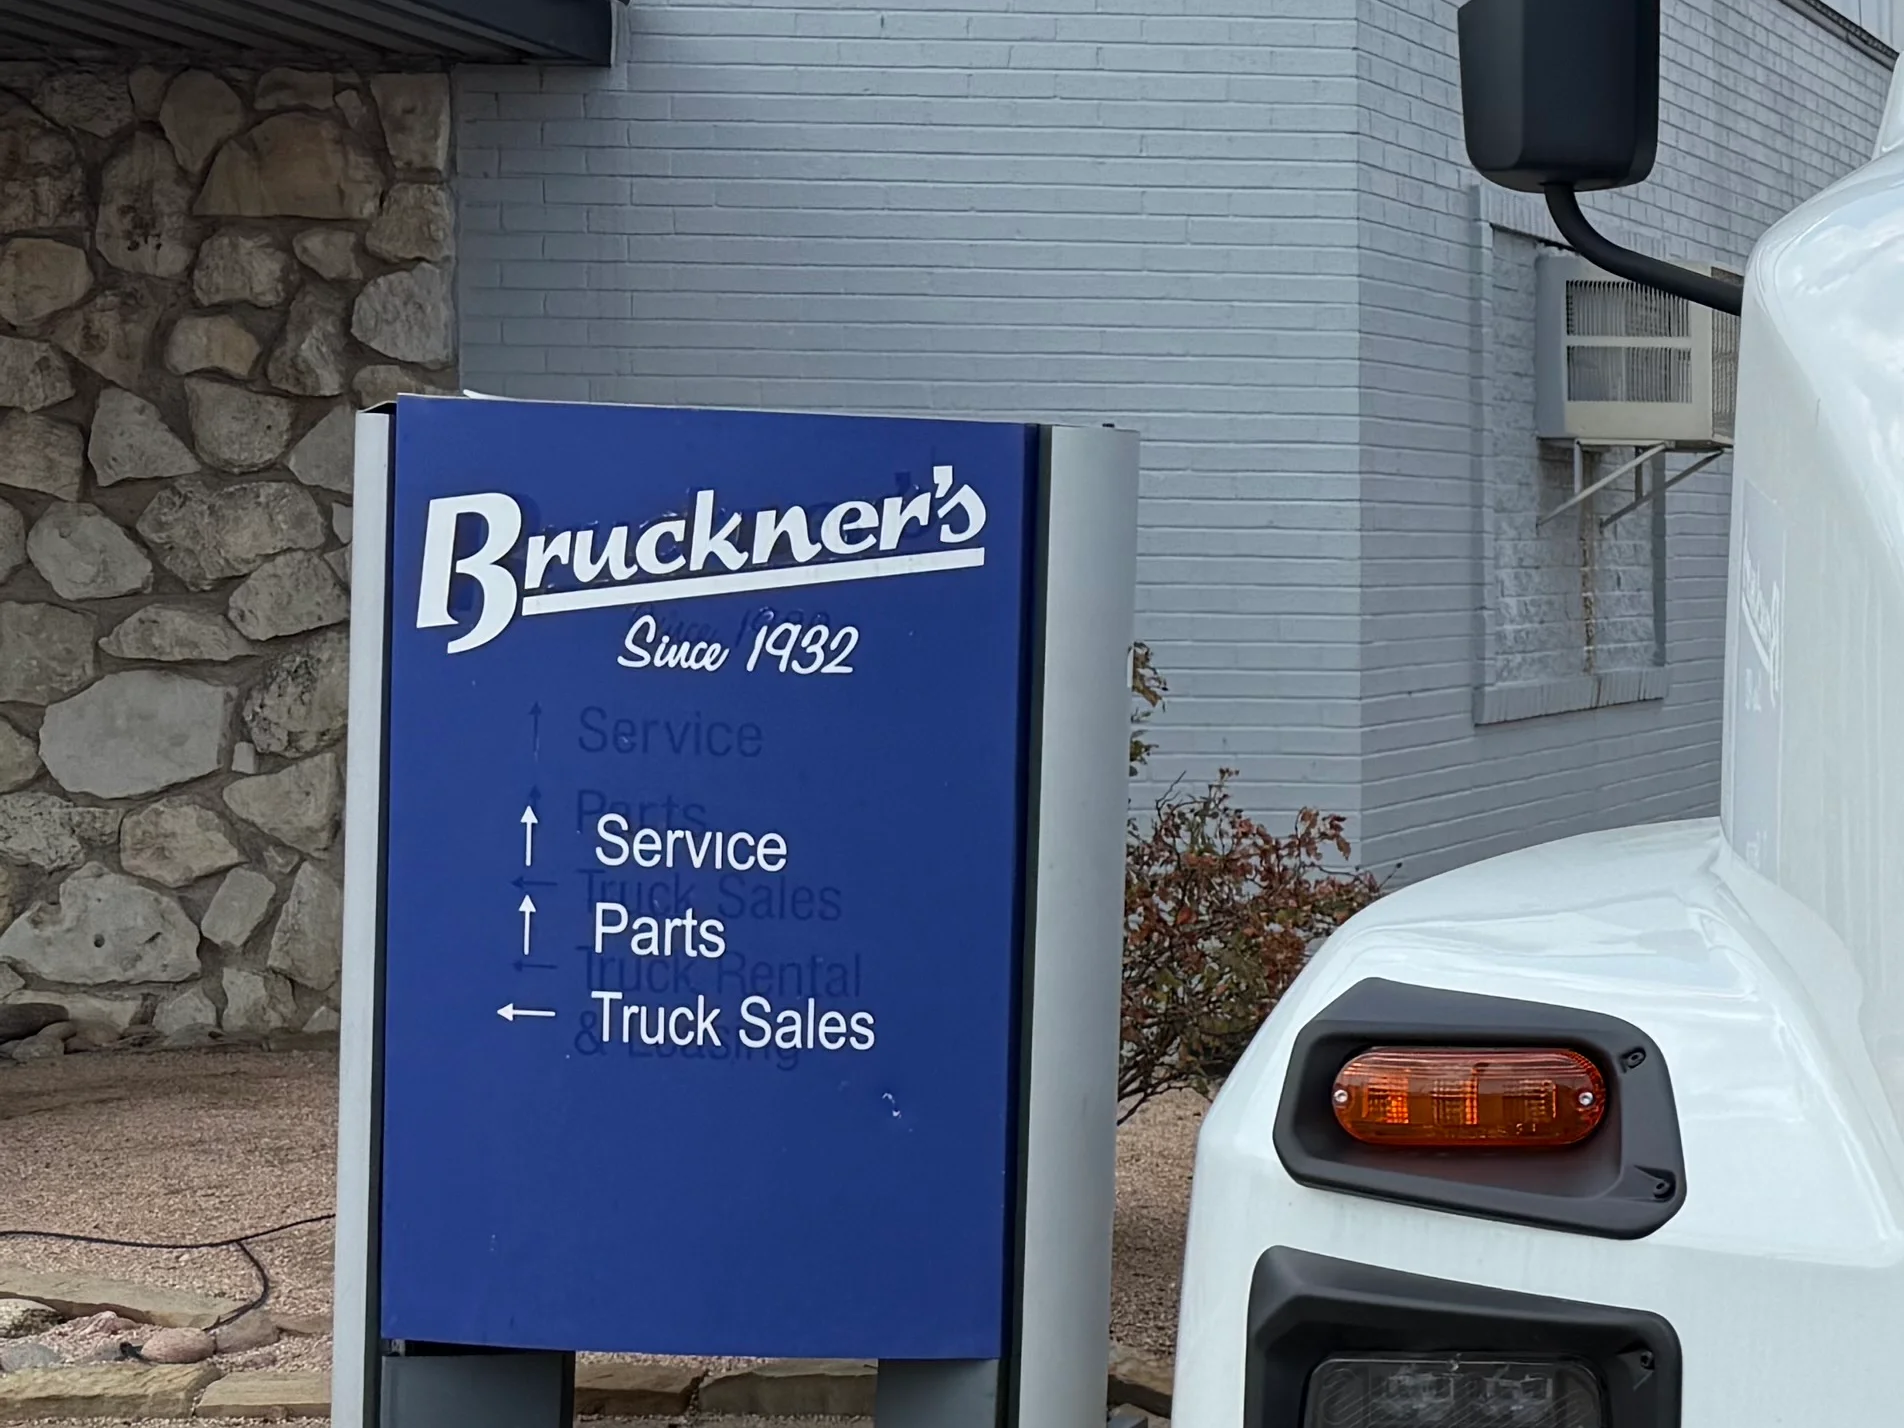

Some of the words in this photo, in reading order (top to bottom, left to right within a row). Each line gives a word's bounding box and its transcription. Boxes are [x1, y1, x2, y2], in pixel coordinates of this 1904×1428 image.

[416, 465, 988, 654] Bruckner's
[617, 615, 730, 672] Since
[746, 622, 860, 674] 1932
[578, 705, 763, 758] Service
[596, 813, 788, 872] Service
[717, 874, 842, 921] Sales
[594, 902, 726, 958] Parts
[717, 950, 861, 998] Rental
[591, 990, 722, 1047] Truck
[739, 995, 876, 1050] Sales
